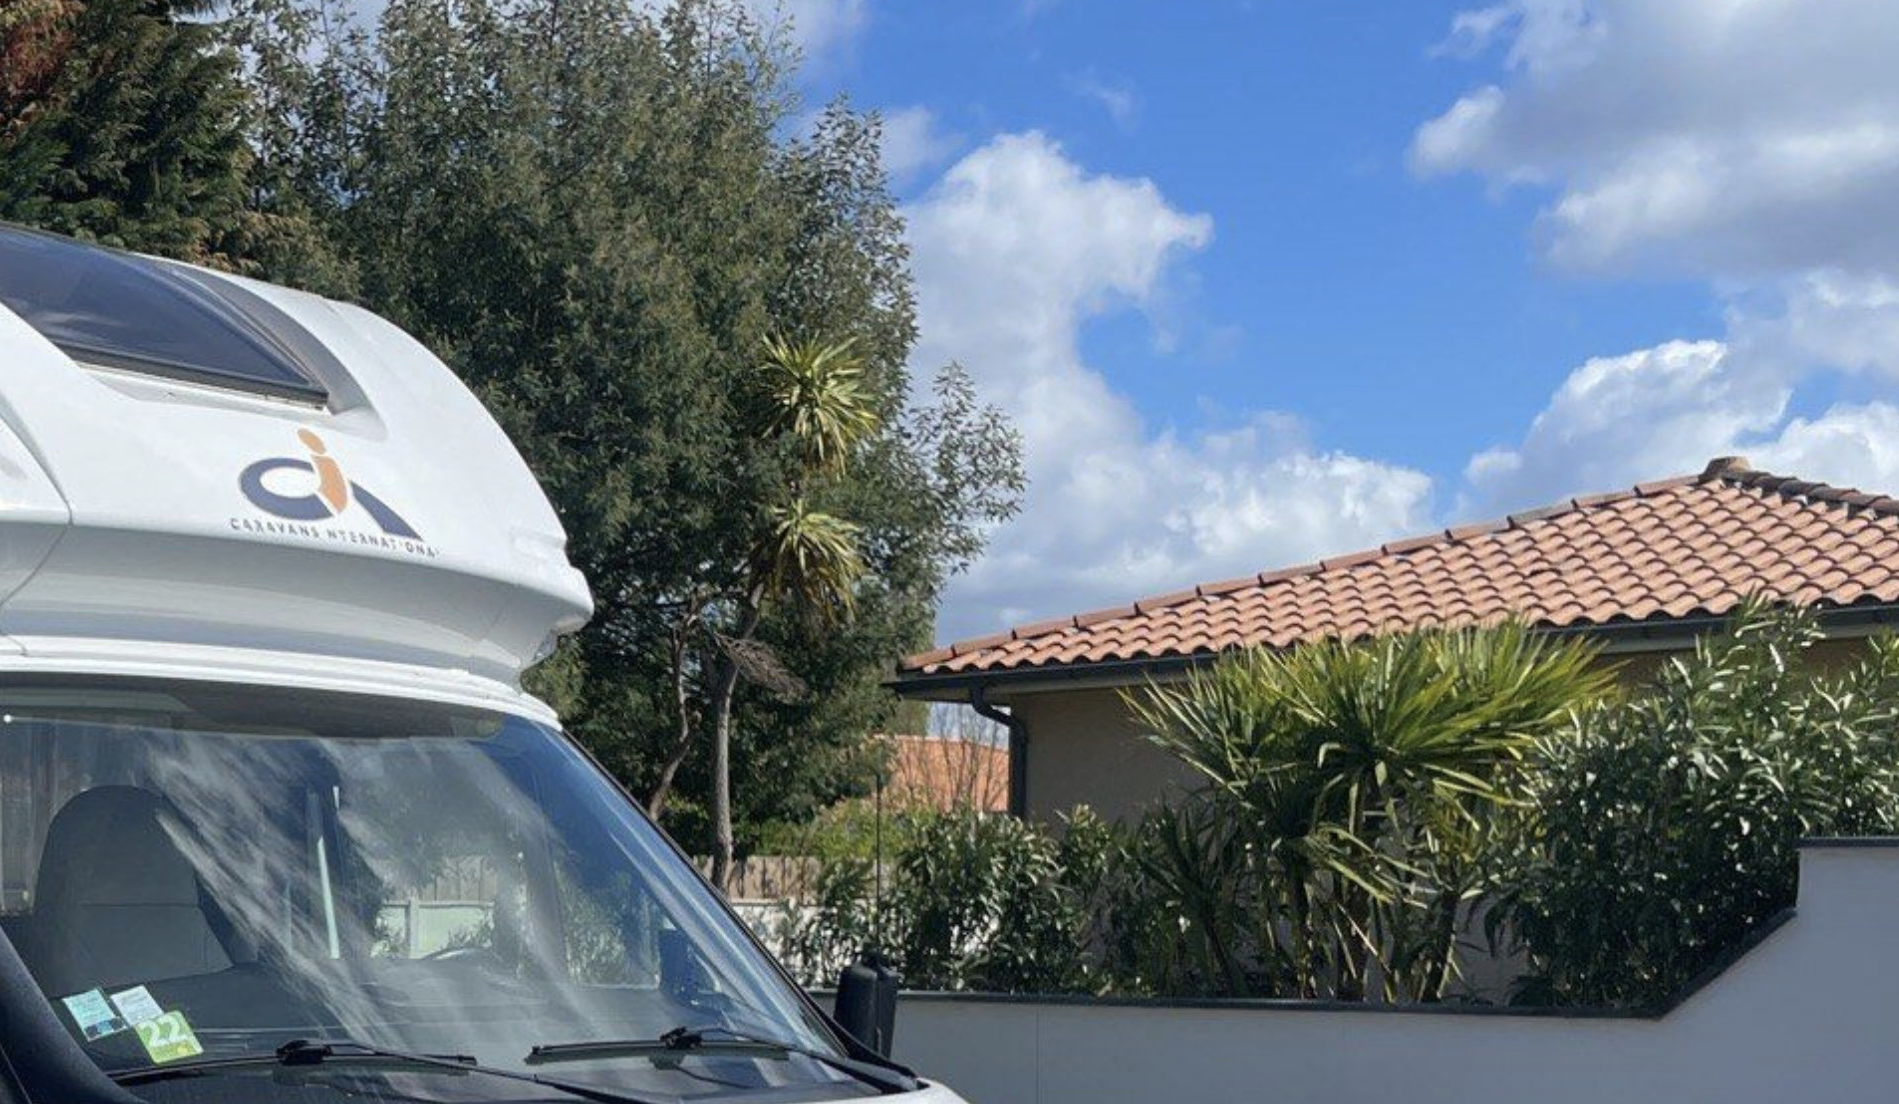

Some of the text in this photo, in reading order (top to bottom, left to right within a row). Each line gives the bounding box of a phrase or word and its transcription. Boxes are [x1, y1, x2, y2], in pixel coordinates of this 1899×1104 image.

[230, 518, 439, 559] CARAVANS NTERNATONA
[137, 1011, 190, 1048] 22
